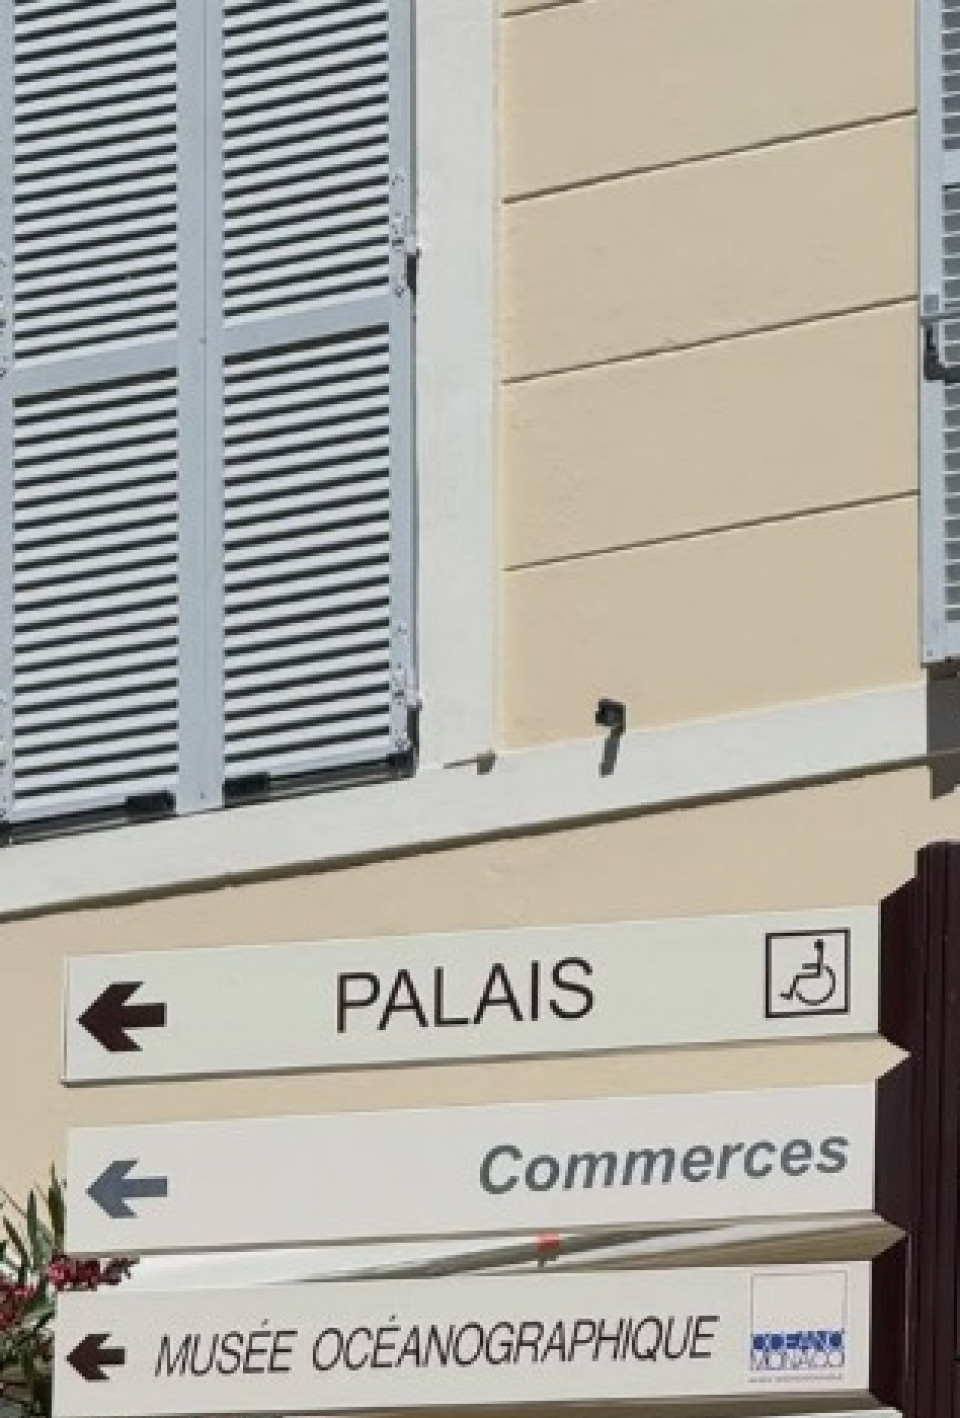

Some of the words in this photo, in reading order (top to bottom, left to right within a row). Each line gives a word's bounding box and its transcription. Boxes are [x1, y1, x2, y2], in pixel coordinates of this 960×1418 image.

[337, 957, 594, 1033] PALAIS
[479, 1136, 849, 1195] Commerces
[154, 1317, 297, 1377] MUSÉE
[312, 1313, 722, 1372] OCÉANOGRAPHIQUE
